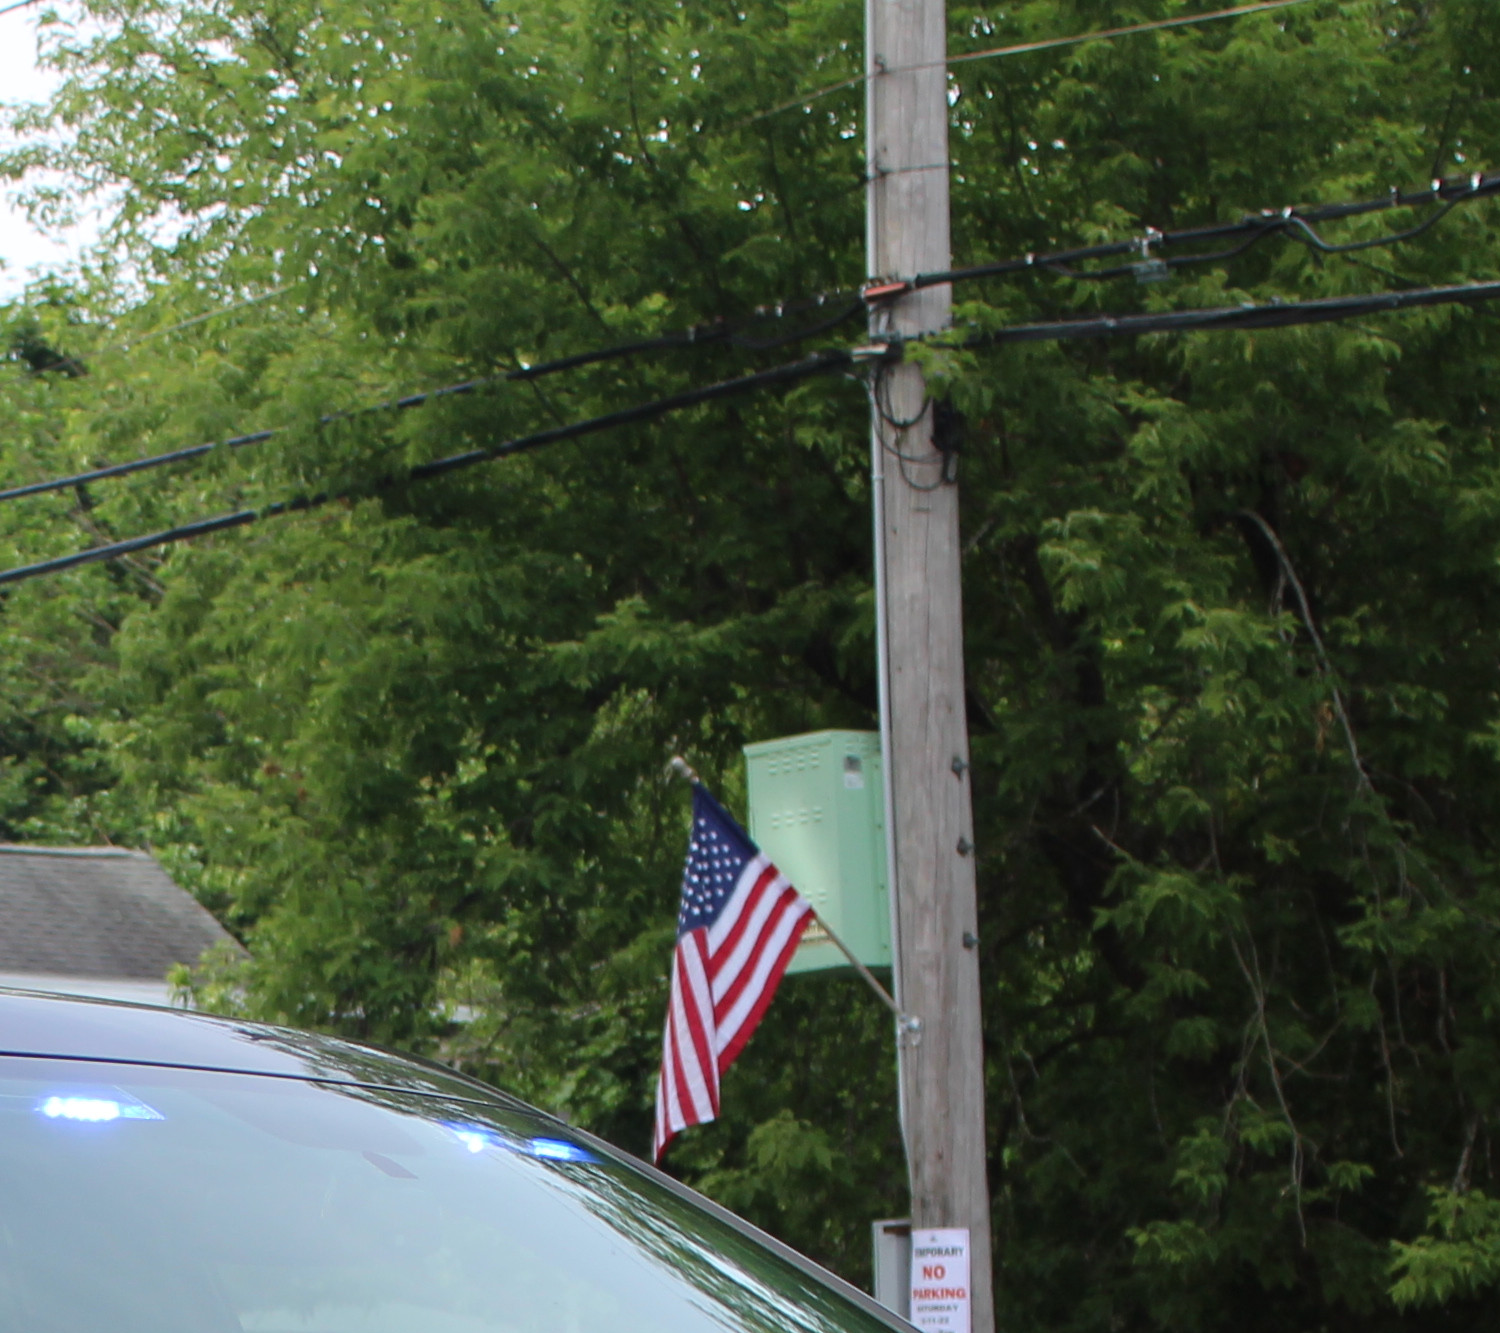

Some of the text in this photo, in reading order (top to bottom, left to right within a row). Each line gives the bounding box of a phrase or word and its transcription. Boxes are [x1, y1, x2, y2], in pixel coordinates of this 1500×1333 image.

[914, 1246, 965, 1258] EMPORARY
[922, 1264, 946, 1281] NO
[912, 1286, 966, 1301] PARKING
